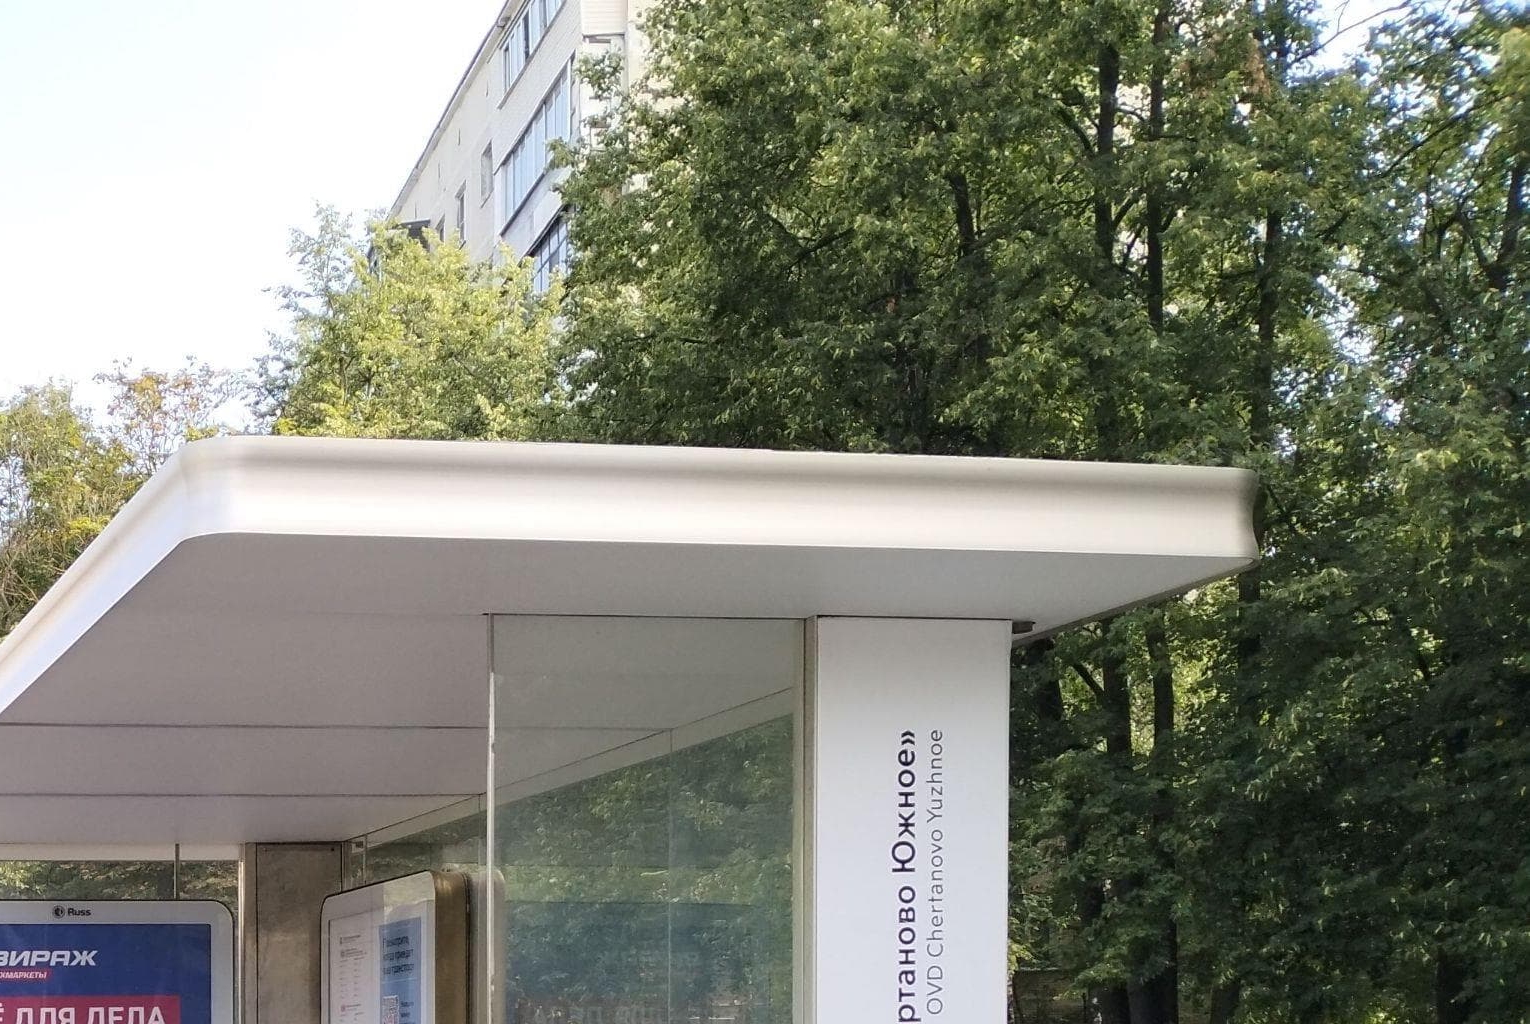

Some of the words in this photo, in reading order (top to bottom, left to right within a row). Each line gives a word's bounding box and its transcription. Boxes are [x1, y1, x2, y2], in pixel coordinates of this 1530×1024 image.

[891, 730, 916, 872] Южное»
[926, 729, 943, 823] Yuzhnoe
[67, 907, 92, 916] Russ
[926, 829, 944, 957] Chertanovo
[926, 965, 944, 1015] OVD
